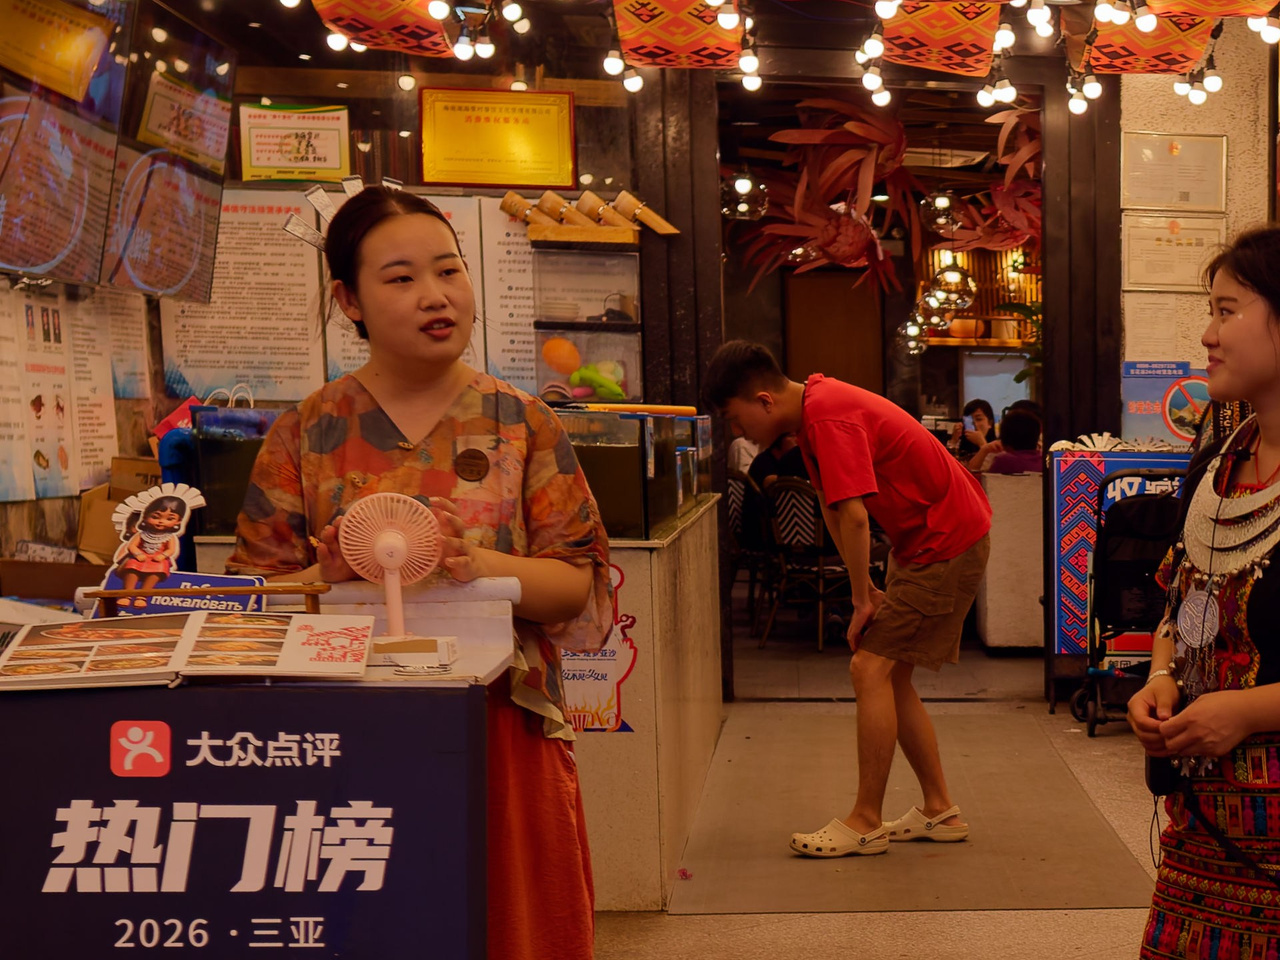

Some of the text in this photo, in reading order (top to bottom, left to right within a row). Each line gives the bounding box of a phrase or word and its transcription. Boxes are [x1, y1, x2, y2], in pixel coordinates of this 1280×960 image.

[151, 594, 244, 611] пожаловать
[185, 731, 342, 768] 大众点评
[41, 799, 395, 893] 热门榜
[114, 918, 209, 948] 2026
